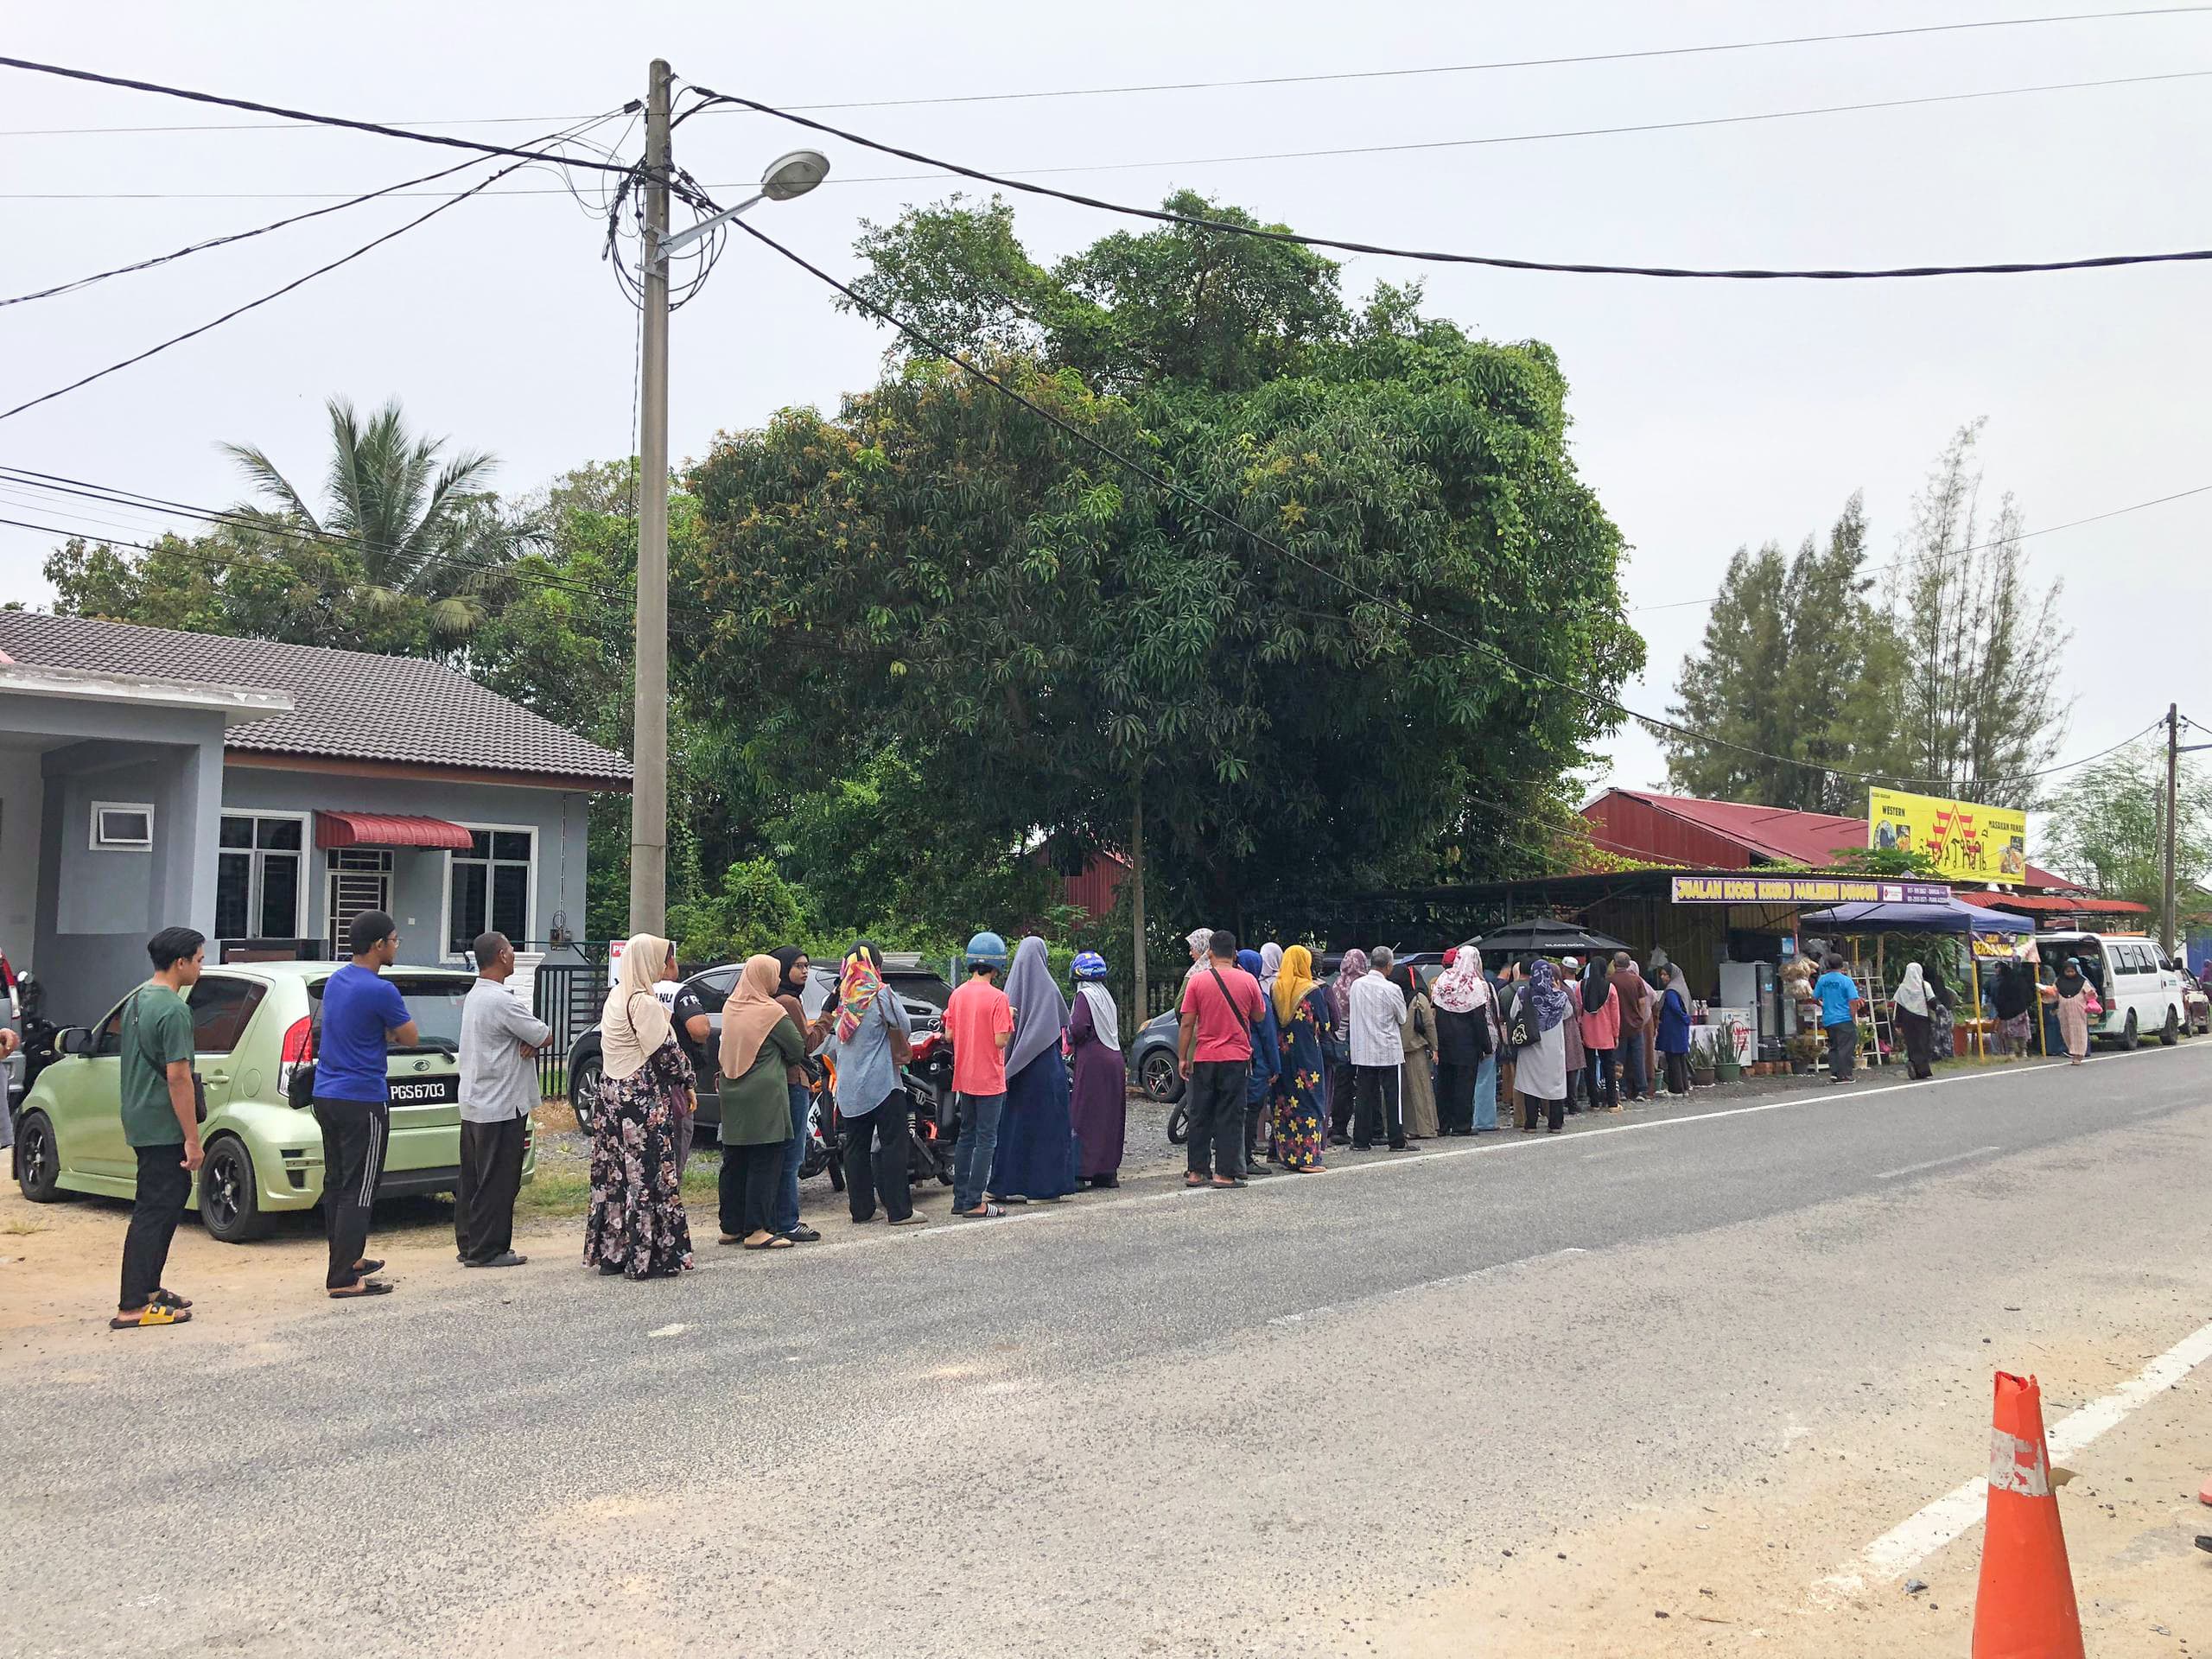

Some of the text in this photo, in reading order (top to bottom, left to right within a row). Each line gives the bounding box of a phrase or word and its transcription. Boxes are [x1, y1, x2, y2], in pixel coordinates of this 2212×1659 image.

[1882, 804, 1905, 817] WESTERN
[1677, 880, 1722, 899] JUALAN
[1724, 880, 1757, 899] KIOSK
